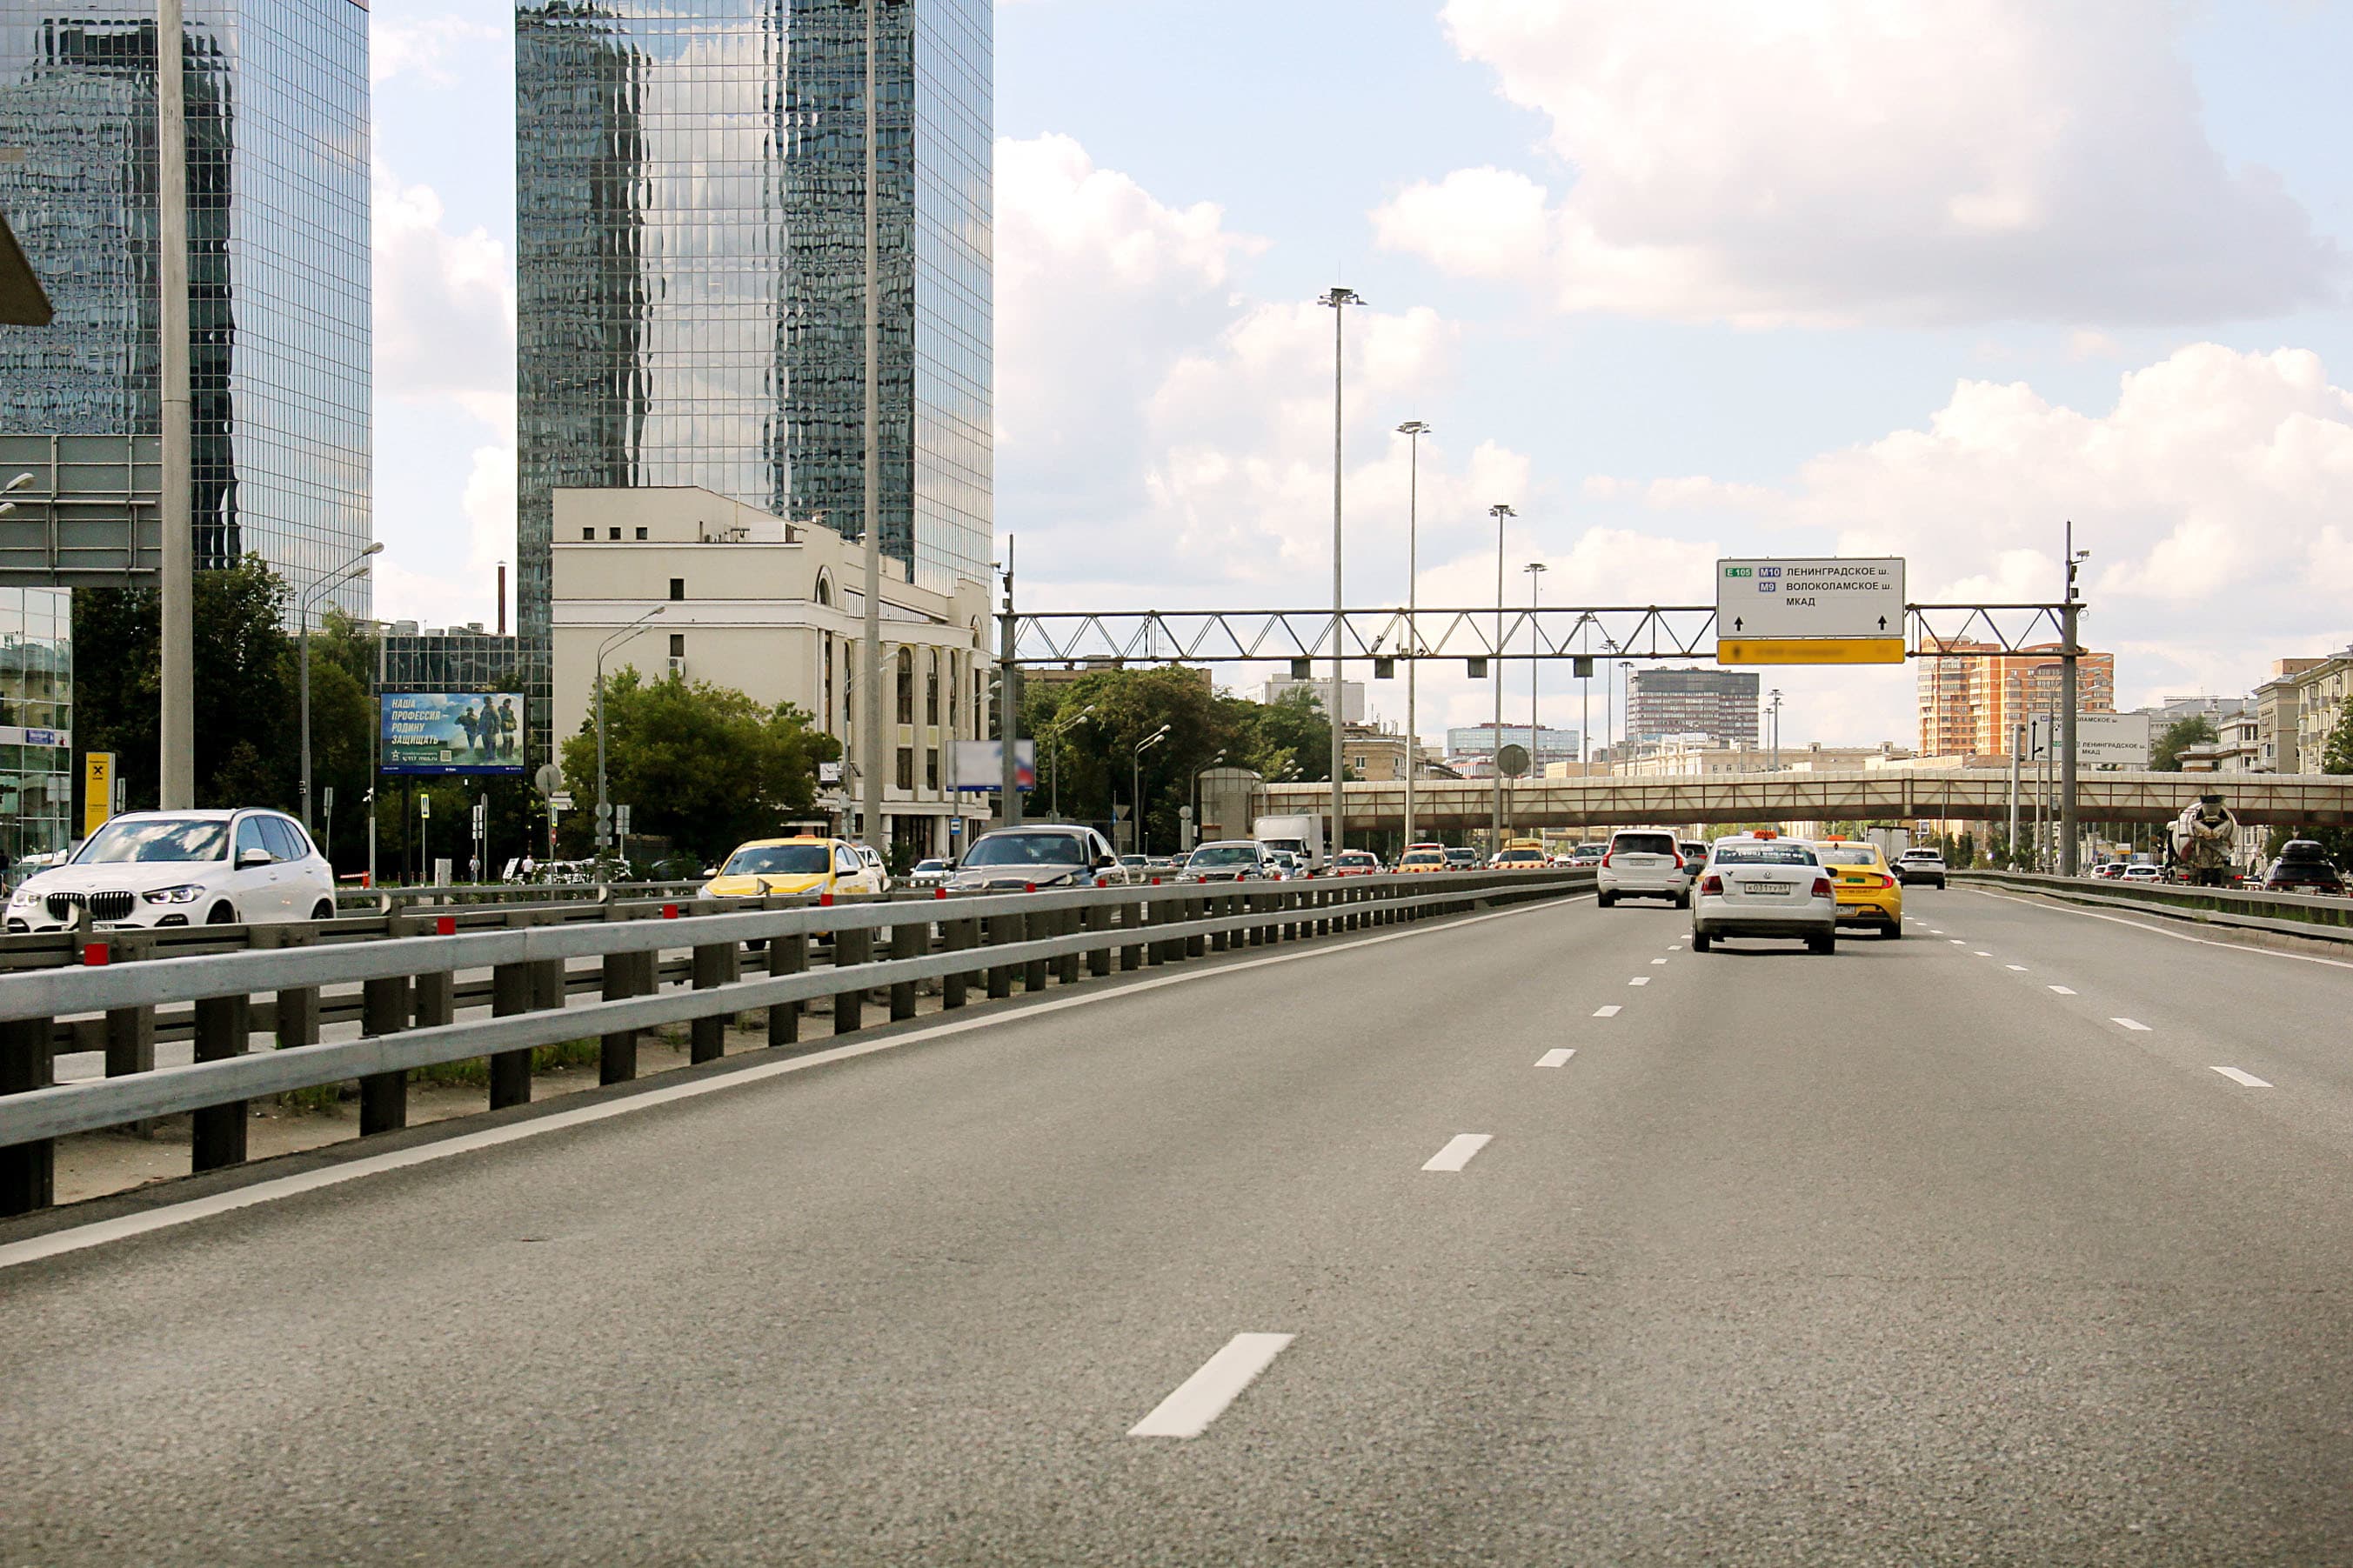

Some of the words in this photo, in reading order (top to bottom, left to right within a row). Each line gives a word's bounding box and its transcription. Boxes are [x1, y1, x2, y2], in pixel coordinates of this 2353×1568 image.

[1735, 568, 1751, 577] 105
[1760, 568, 1780, 577] М10
[1786, 567, 1875, 577] ЛЕНИНГРАДСКОЕ
[1786, 582, 1879, 591] ВОЛОКОЛАМСКОЕ
[1786, 597, 1815, 606] МКАД
[391, 699, 416, 708] НАША
[391, 711, 441, 721] ПРОФЕССИЯ
[391, 723, 425, 733] РОДИНУ
[391, 735, 439, 746] ЗАЩИЩАТЬ
